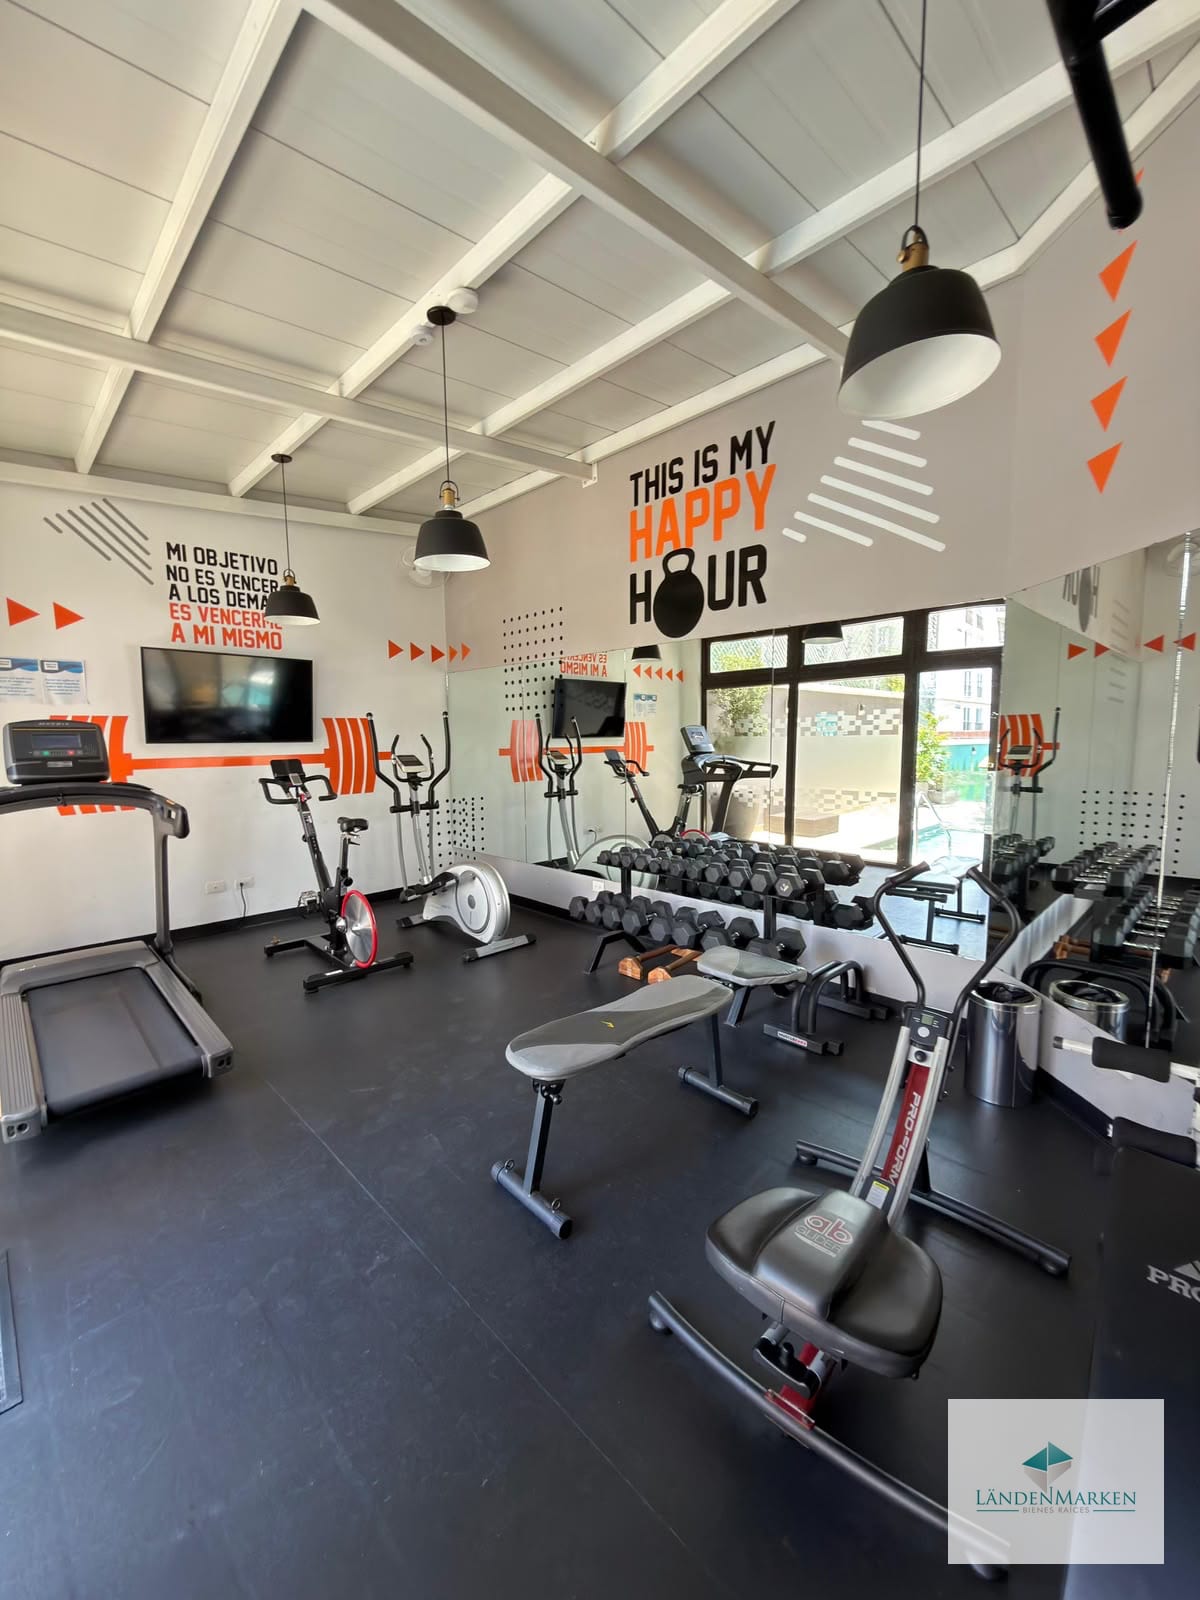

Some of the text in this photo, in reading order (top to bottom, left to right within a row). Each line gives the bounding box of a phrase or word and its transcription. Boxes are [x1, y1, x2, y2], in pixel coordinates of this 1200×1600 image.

[630, 420, 776, 507] THIS IS MY
[629, 463, 776, 563] HAPPY
[166, 541, 278, 575] MI OBJETIVO
[166, 564, 278, 593] NO ES VENCER
[169, 583, 268, 611] A LOS DEMA
[169, 602, 283, 630] ES VENCER
[171, 622, 283, 650] A MI MISMO
[889, 1091, 922, 1187] PRO-FORM
[804, 1215, 853, 1245] ab
